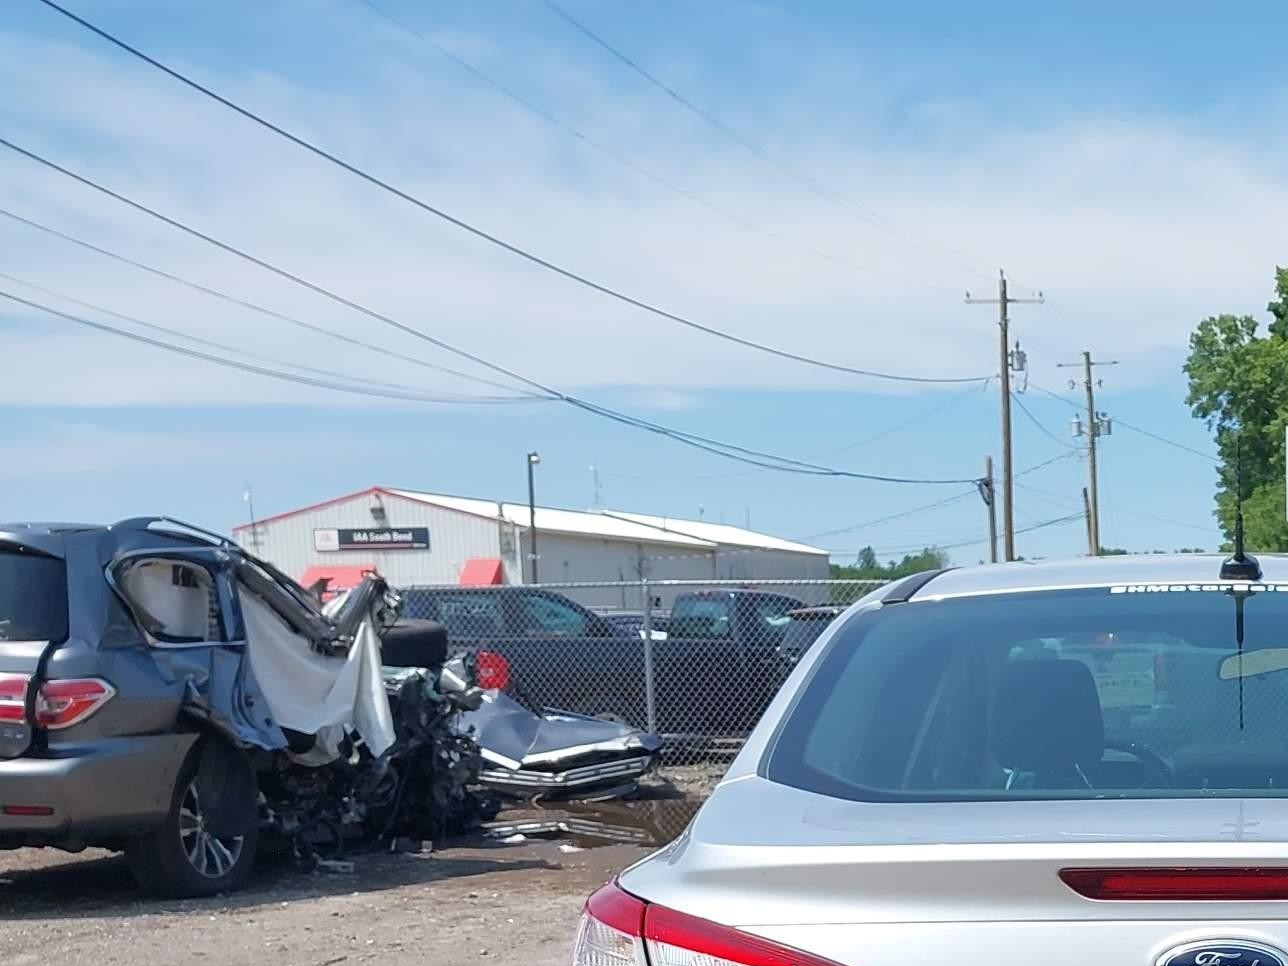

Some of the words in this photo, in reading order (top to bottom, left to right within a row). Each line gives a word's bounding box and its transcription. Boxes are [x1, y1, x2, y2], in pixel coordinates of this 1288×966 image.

[352, 531, 369, 542] IAA
[369, 531, 392, 542] South
[392, 530, 413, 541] Bend
